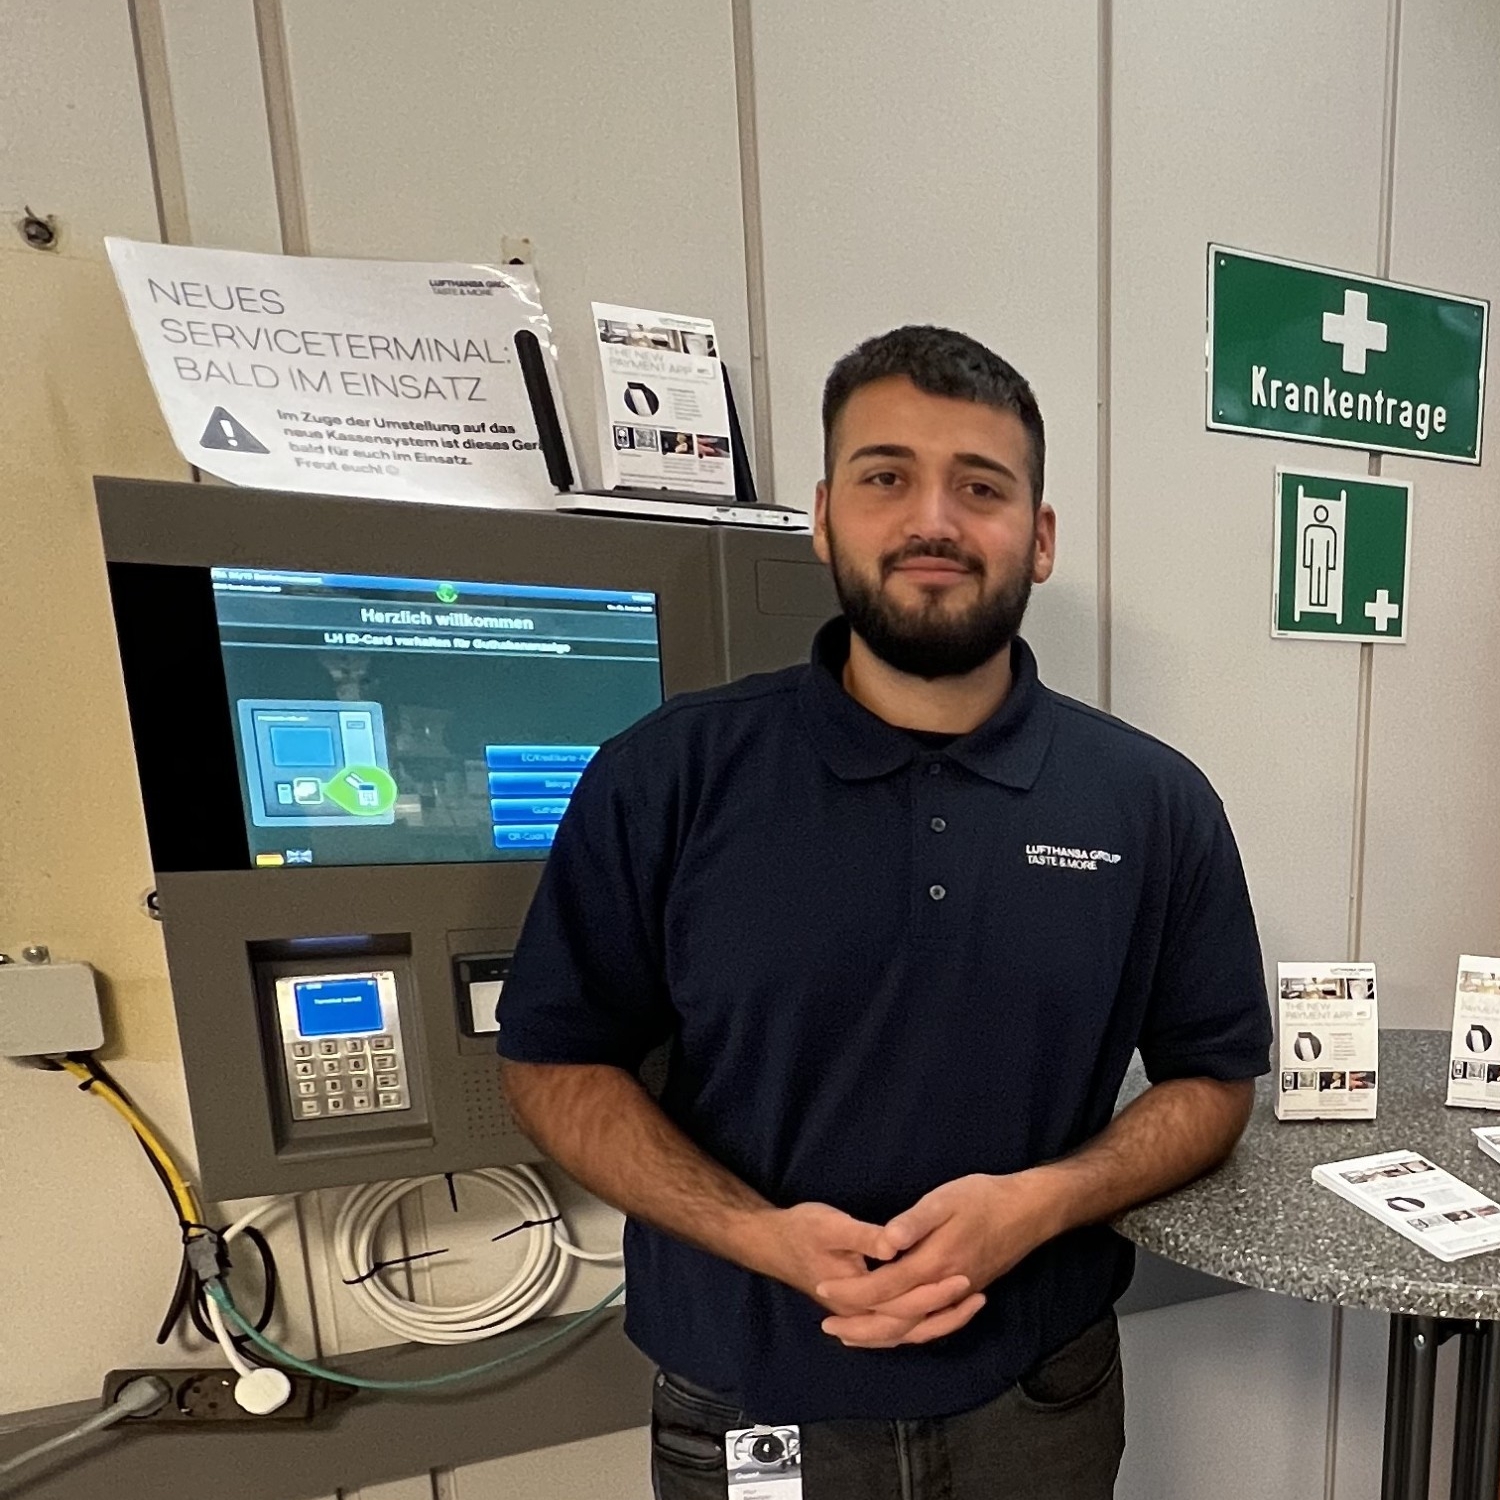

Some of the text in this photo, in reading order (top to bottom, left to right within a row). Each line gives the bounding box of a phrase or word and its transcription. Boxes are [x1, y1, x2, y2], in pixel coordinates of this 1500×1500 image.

[147, 277, 286, 316] NEUES
[160, 317, 512, 365] SERVICETERMINAL:
[173, 355, 488, 402] BALD IM EINSATZ
[1251, 364, 1447, 441] Krankentrage
[276, 408, 517, 436] Im Zuge der Umstellung auf das
[283, 427, 541, 452] neue Kassensystem ist dieses Ger
[414, 451, 473, 467] Einsatz.
[360, 607, 535, 631] Herzlich willkommen
[1025, 844, 1121, 864] LUFTHANSA GROUP
[1027, 855, 1098, 871] TASTE & MORE
